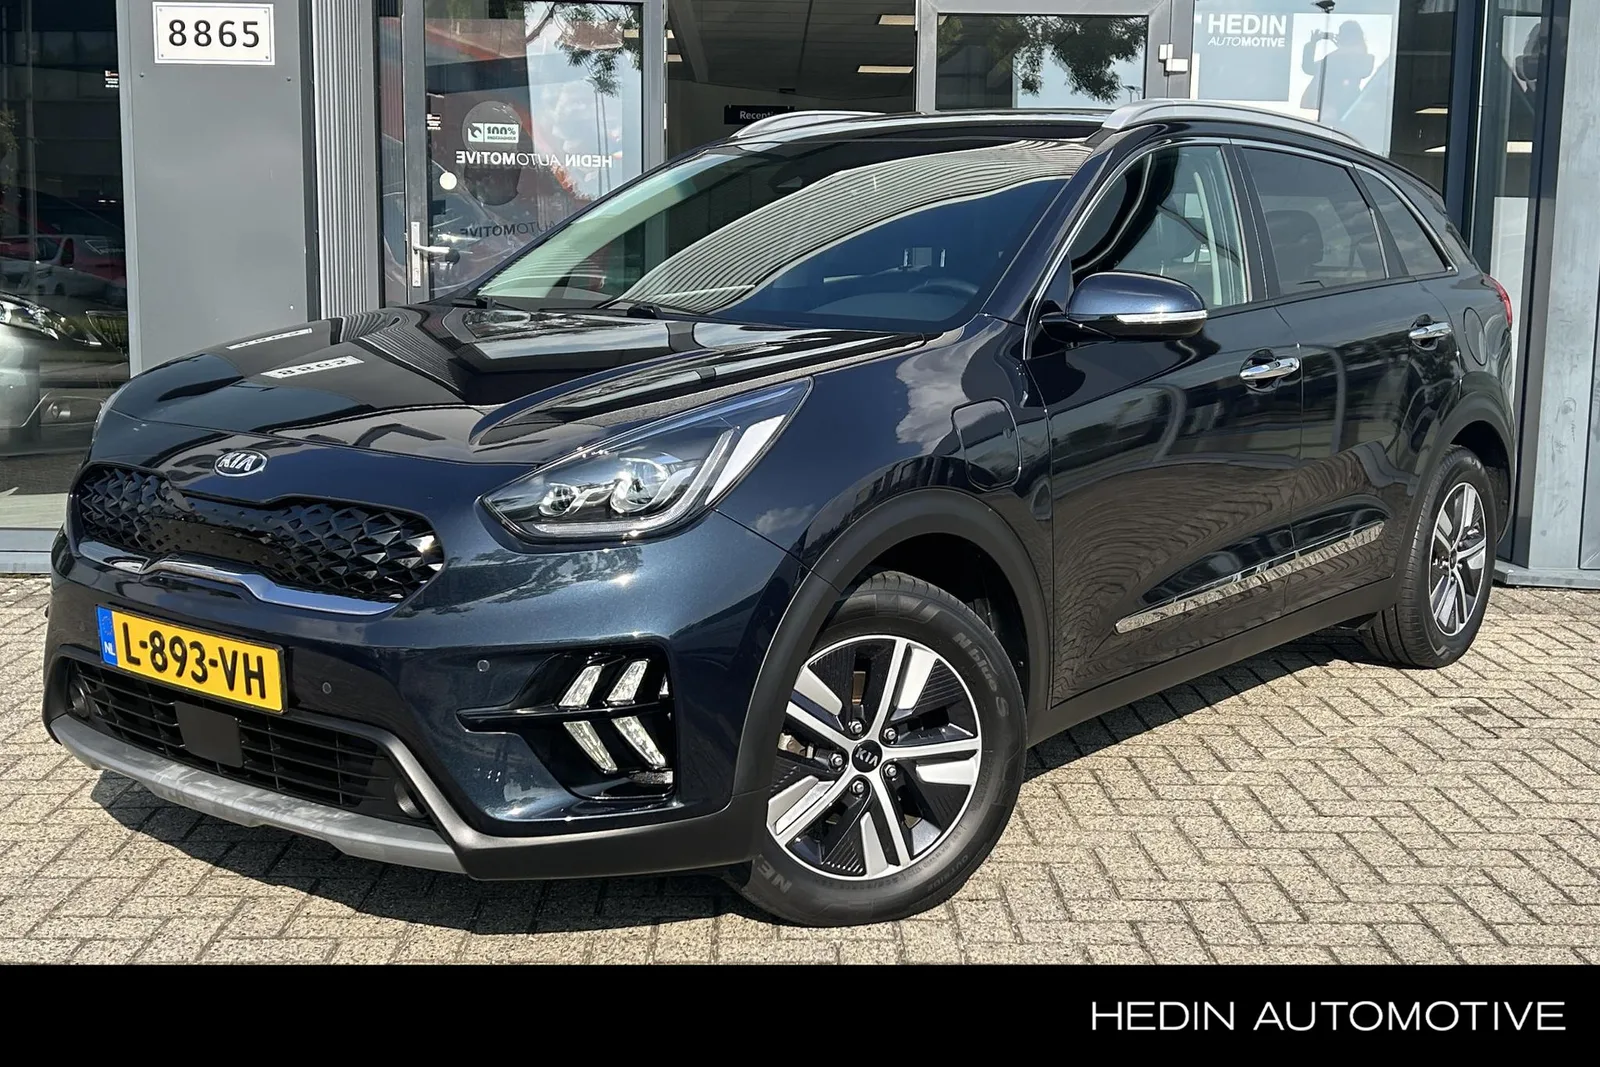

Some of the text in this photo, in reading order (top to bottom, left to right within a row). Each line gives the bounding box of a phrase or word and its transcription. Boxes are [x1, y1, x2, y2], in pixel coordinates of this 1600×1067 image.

[168, 19, 260, 48] 8865
[1207, 13, 1287, 35] HEDIN
[1207, 36, 1286, 47] AUTOMOTIVE
[217, 452, 258, 471] KIA
[104, 622, 266, 699] NL L-893-VH
[855, 747, 879, 767] KIA
